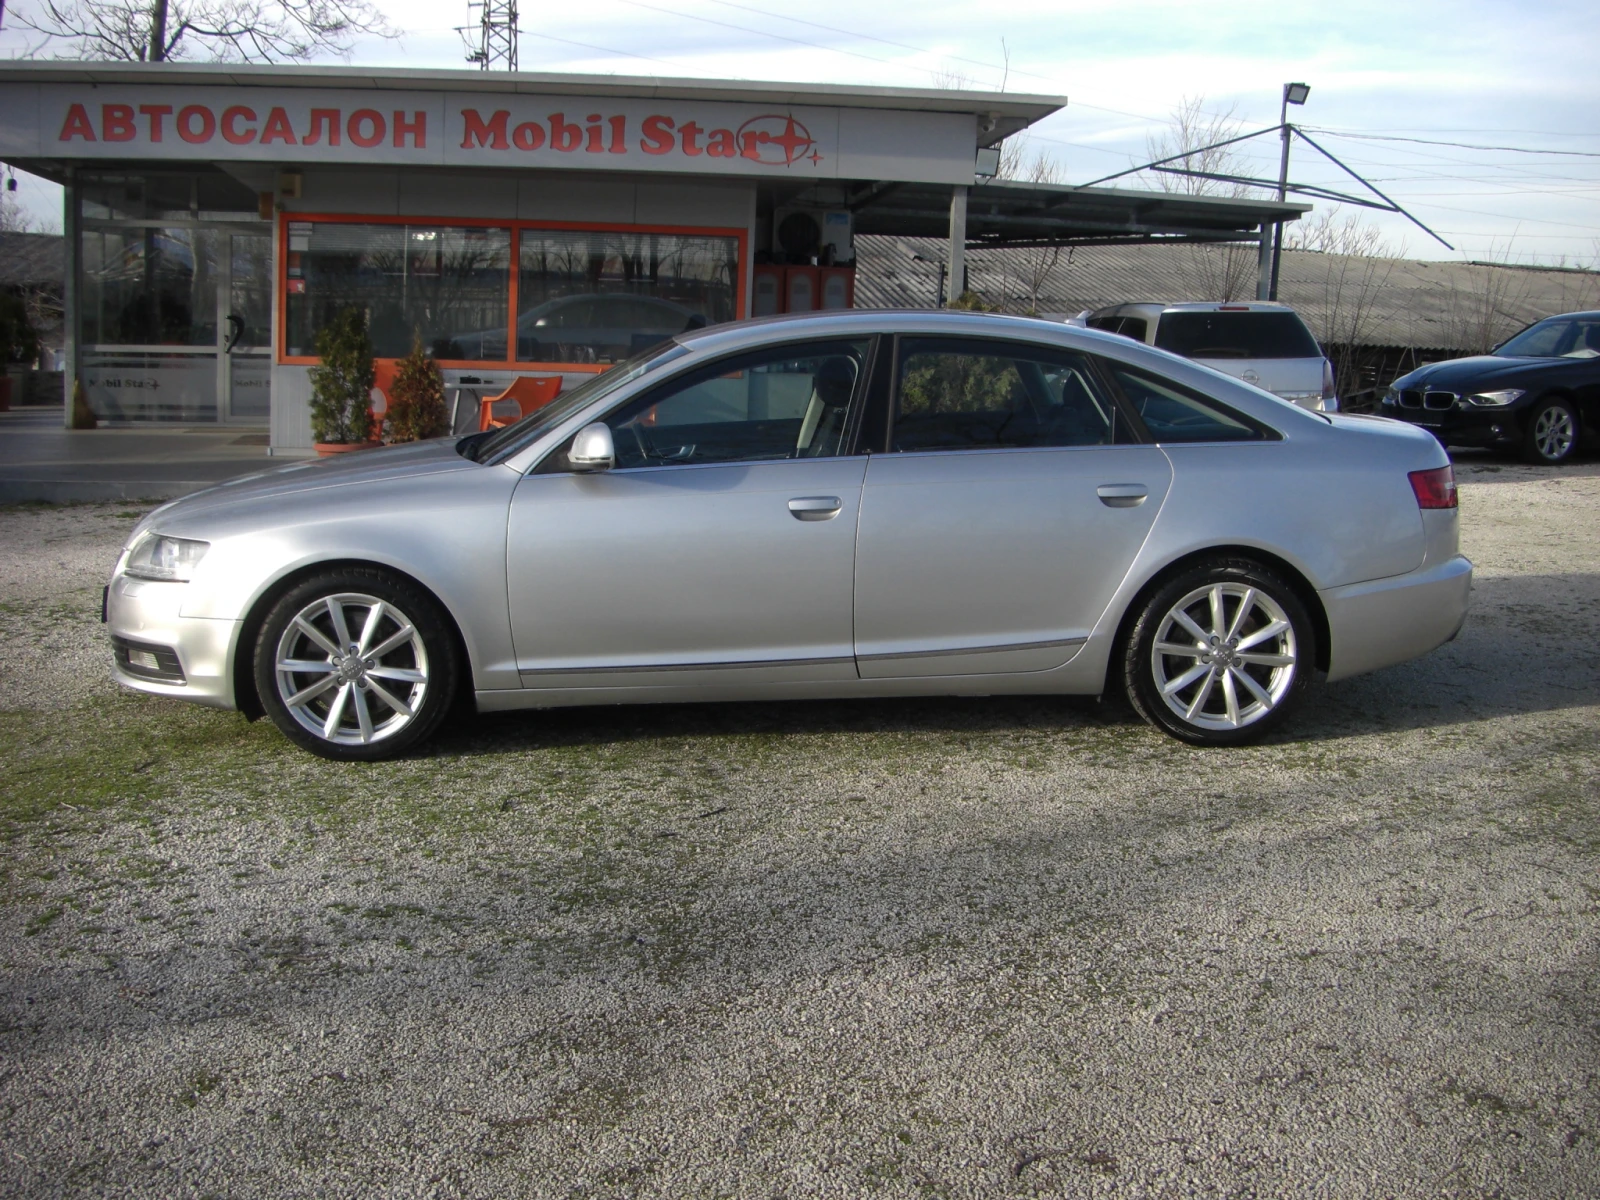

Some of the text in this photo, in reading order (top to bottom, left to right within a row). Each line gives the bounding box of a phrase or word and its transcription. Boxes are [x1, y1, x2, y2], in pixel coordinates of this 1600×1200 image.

[59, 103, 427, 149] АВТОСАЛОН
[459, 108, 770, 159] Mobil Star
